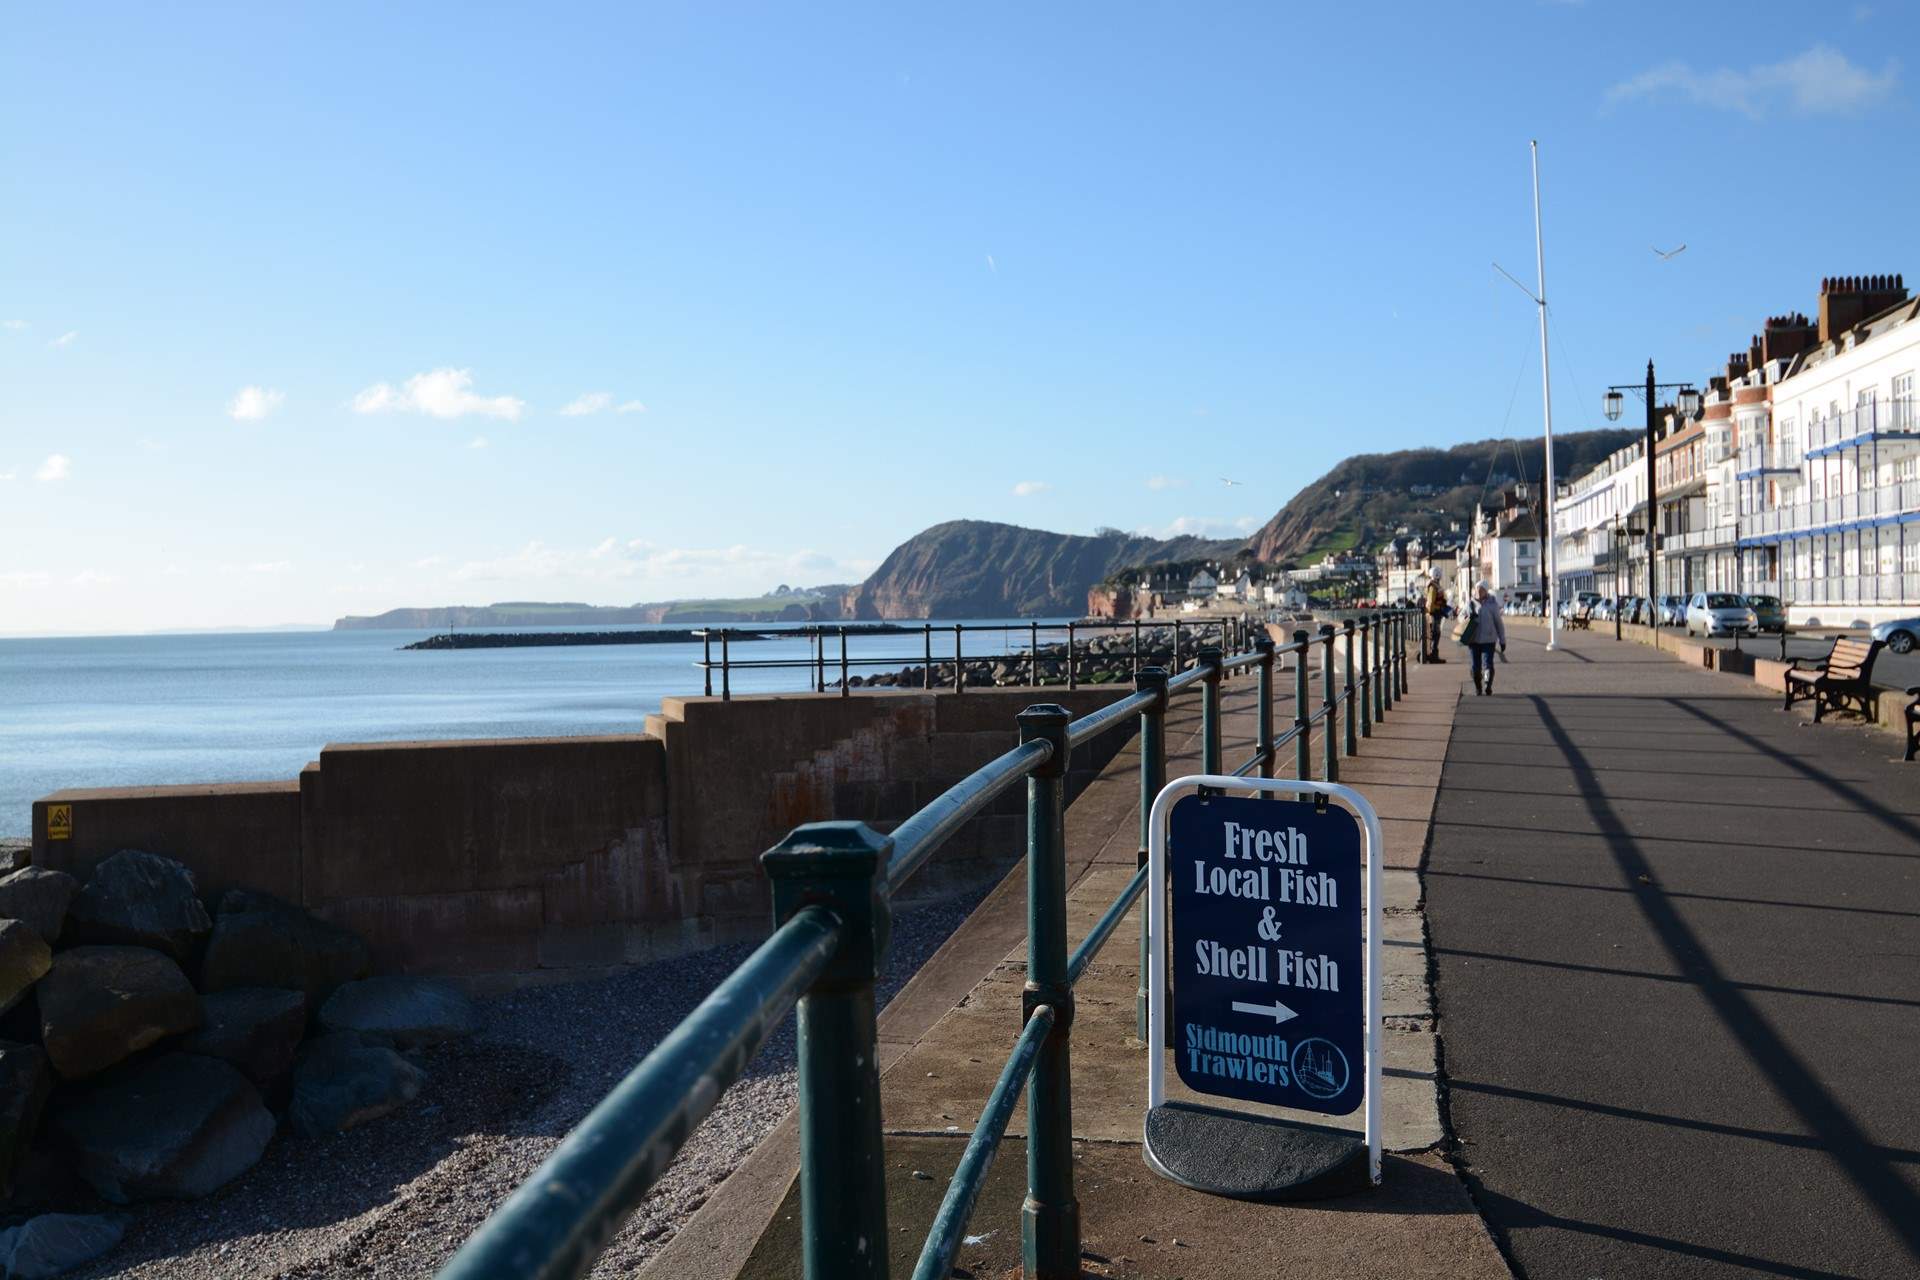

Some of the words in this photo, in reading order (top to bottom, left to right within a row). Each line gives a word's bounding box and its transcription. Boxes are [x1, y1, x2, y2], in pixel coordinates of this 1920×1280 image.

[1224, 821, 1308, 865] Fresh
[1194, 860, 1270, 900] Local
[1279, 868, 1338, 908] Fish
[1257, 905, 1282, 942] &
[1195, 939, 1268, 983] Shell
[1277, 950, 1339, 992] Fish
[1185, 1022, 1289, 1063] Sidmouth
[1187, 1047, 1290, 1088] Trawlers
